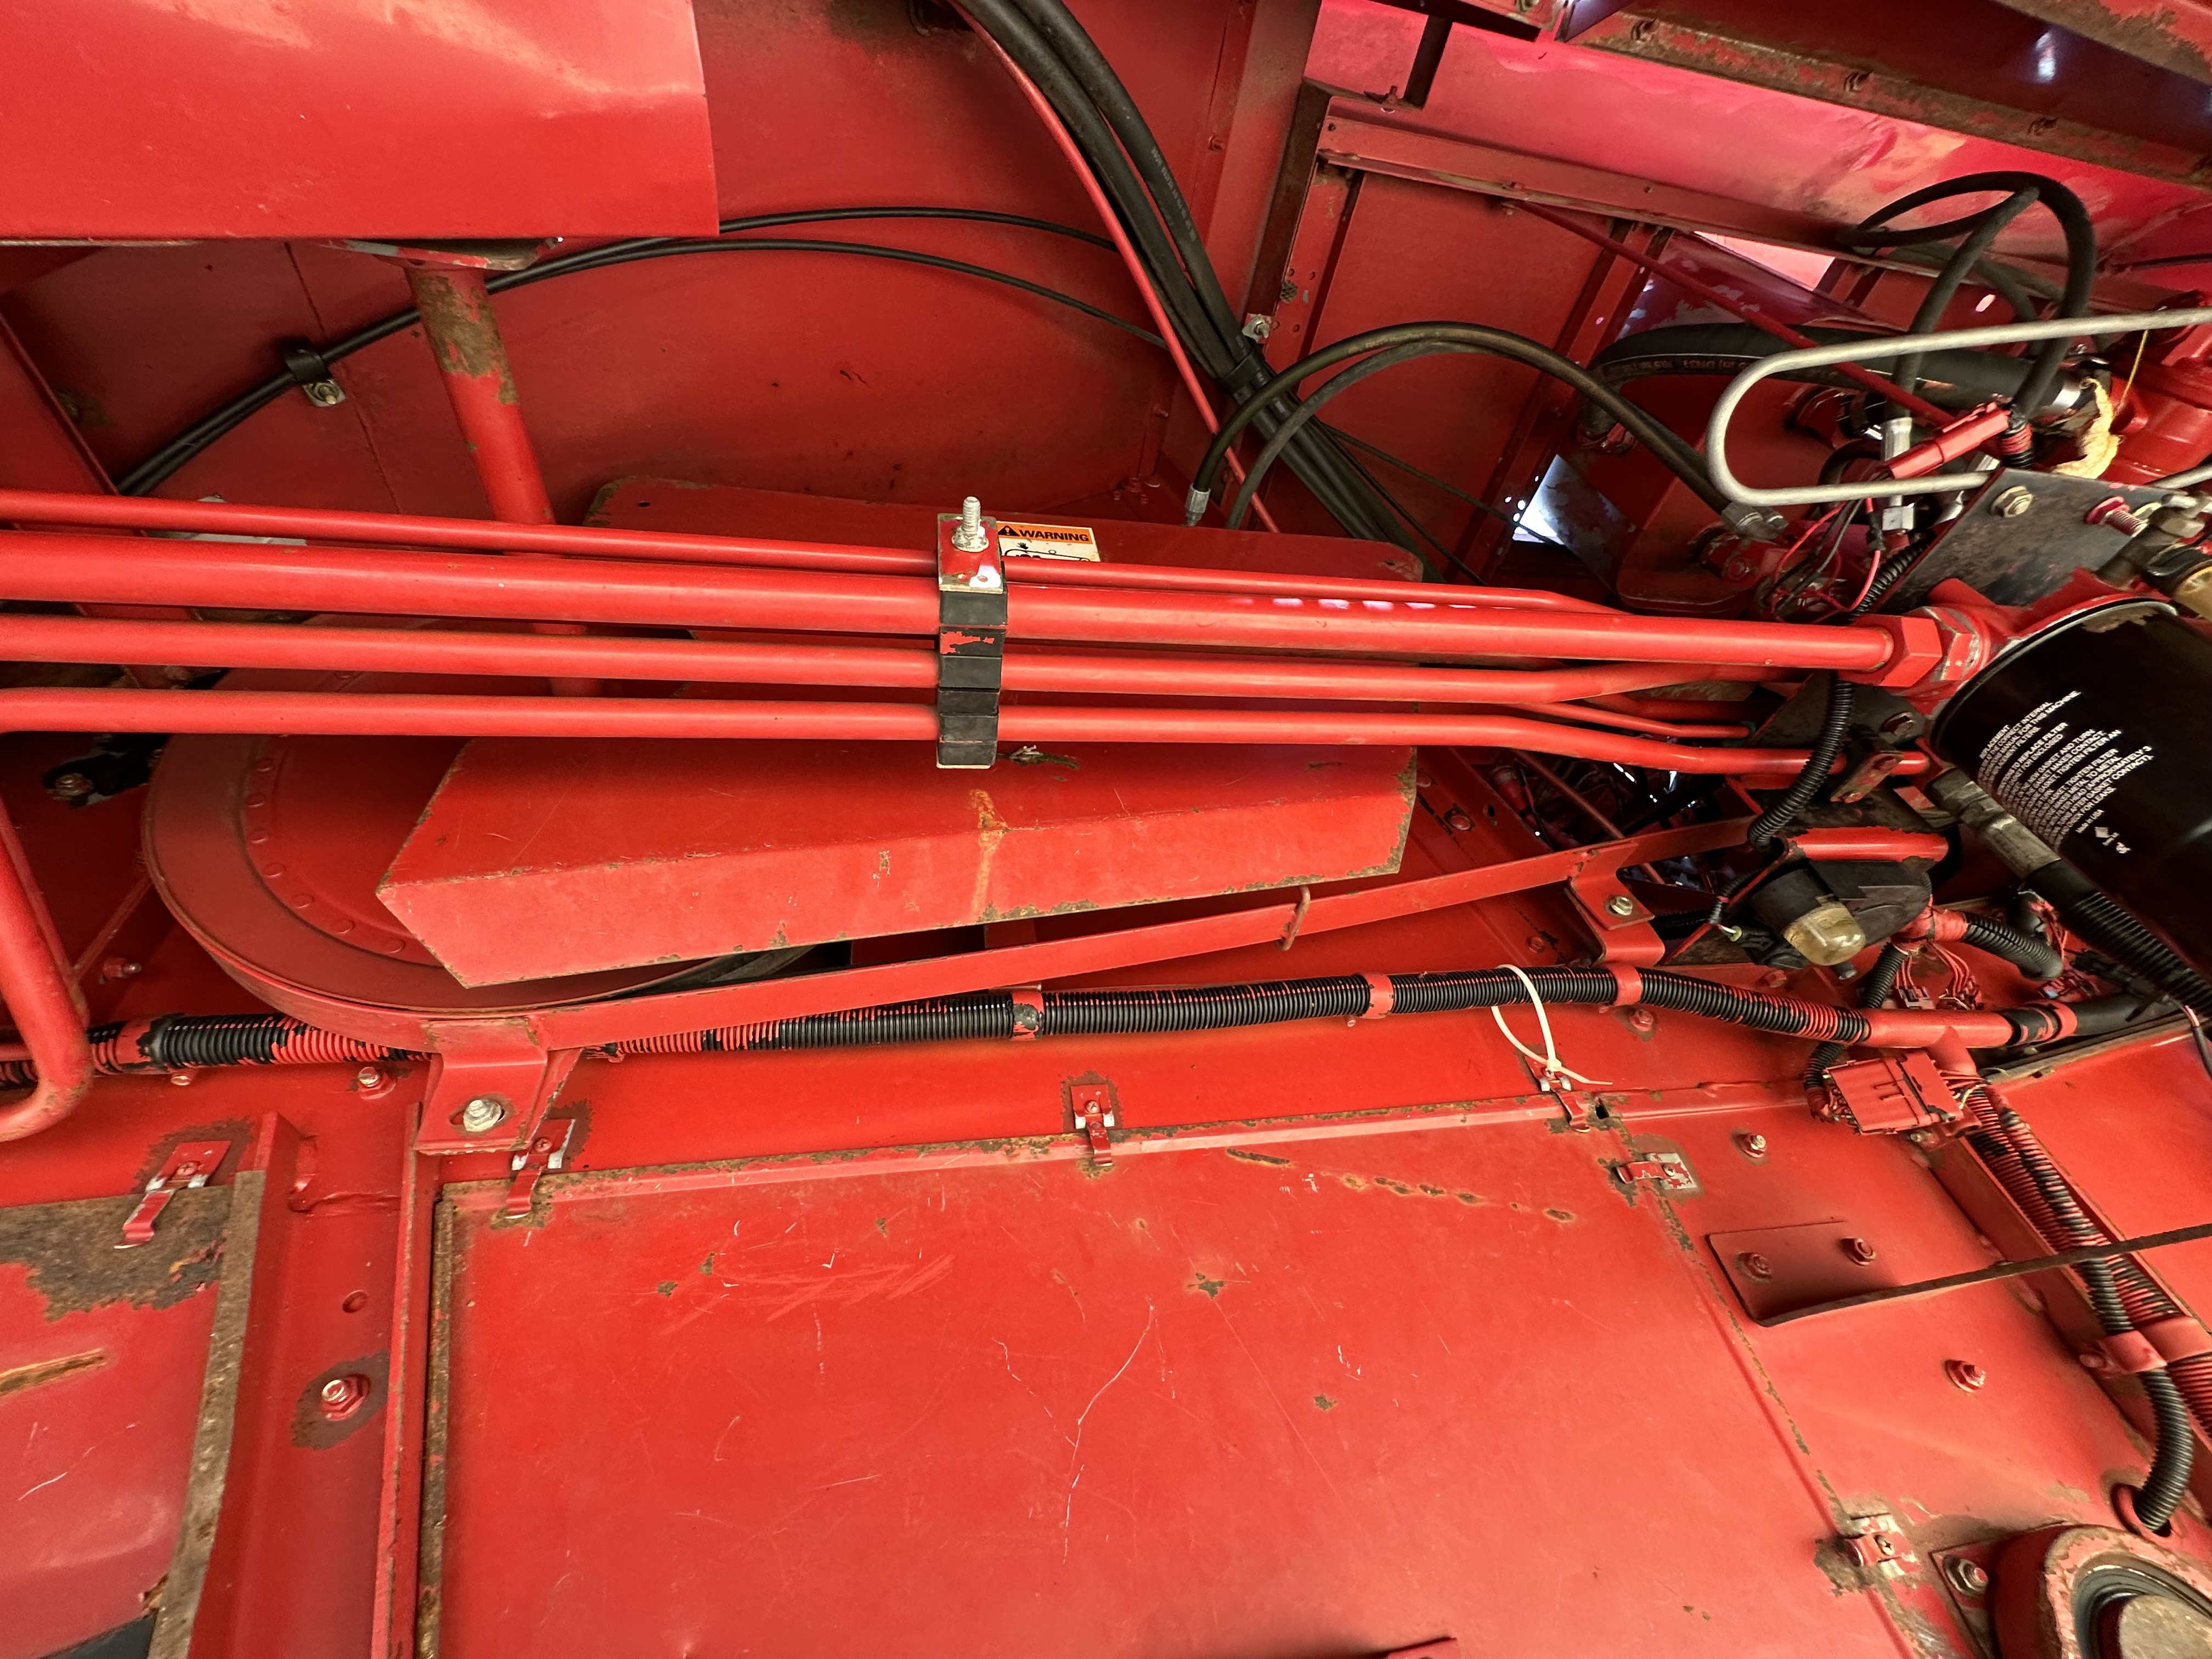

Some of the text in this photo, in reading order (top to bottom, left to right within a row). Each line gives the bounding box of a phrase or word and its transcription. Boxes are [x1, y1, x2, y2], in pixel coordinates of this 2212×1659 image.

[1019, 529, 1089, 541] WARNING
[1979, 725, 2010, 759] REPLACEMENT
[1997, 722, 2023, 746] CORRECT
[1999, 735, 2021, 753] MANUAL
[2017, 723, 2033, 735] FOR
[2029, 712, 2047, 724] THIS
[2017, 739, 2045, 763] REPLACE
[2041, 722, 2068, 741] FILTER
[2021, 758, 2034, 770] FOR
[2030, 733, 2063, 760] ENCLOSED
[2027, 771, 2040, 783] NEW
[2037, 752, 2061, 773] GASKET
[2059, 742, 2075, 755] AND
[2071, 729, 2095, 744] TURN
[2032, 769, 2053, 788] GASKET
[2050, 752, 2073, 771] MAKES
[2056, 753, 2085, 774] TIGHTEN
[2082, 737, 2109, 754] FILTER
[2108, 730, 2121, 738] AN
[2064, 764, 2094, 786] TIGHTEN
[2090, 748, 2118, 766] FILTER
[2052, 792, 2070, 809] MAKES
[2068, 778, 2090, 794] METAL
[2095, 755, 2123, 771] METAL
[2069, 787, 2087, 802] HEAD
[2085, 748, 2144, 791] (APPROXIMATELY
[2069, 796, 2089, 813] AFTER
[2085, 777, 2113, 799] GASKET
[2079, 802, 2095, 814] FOR
[2090, 809, 2104, 820] USA
